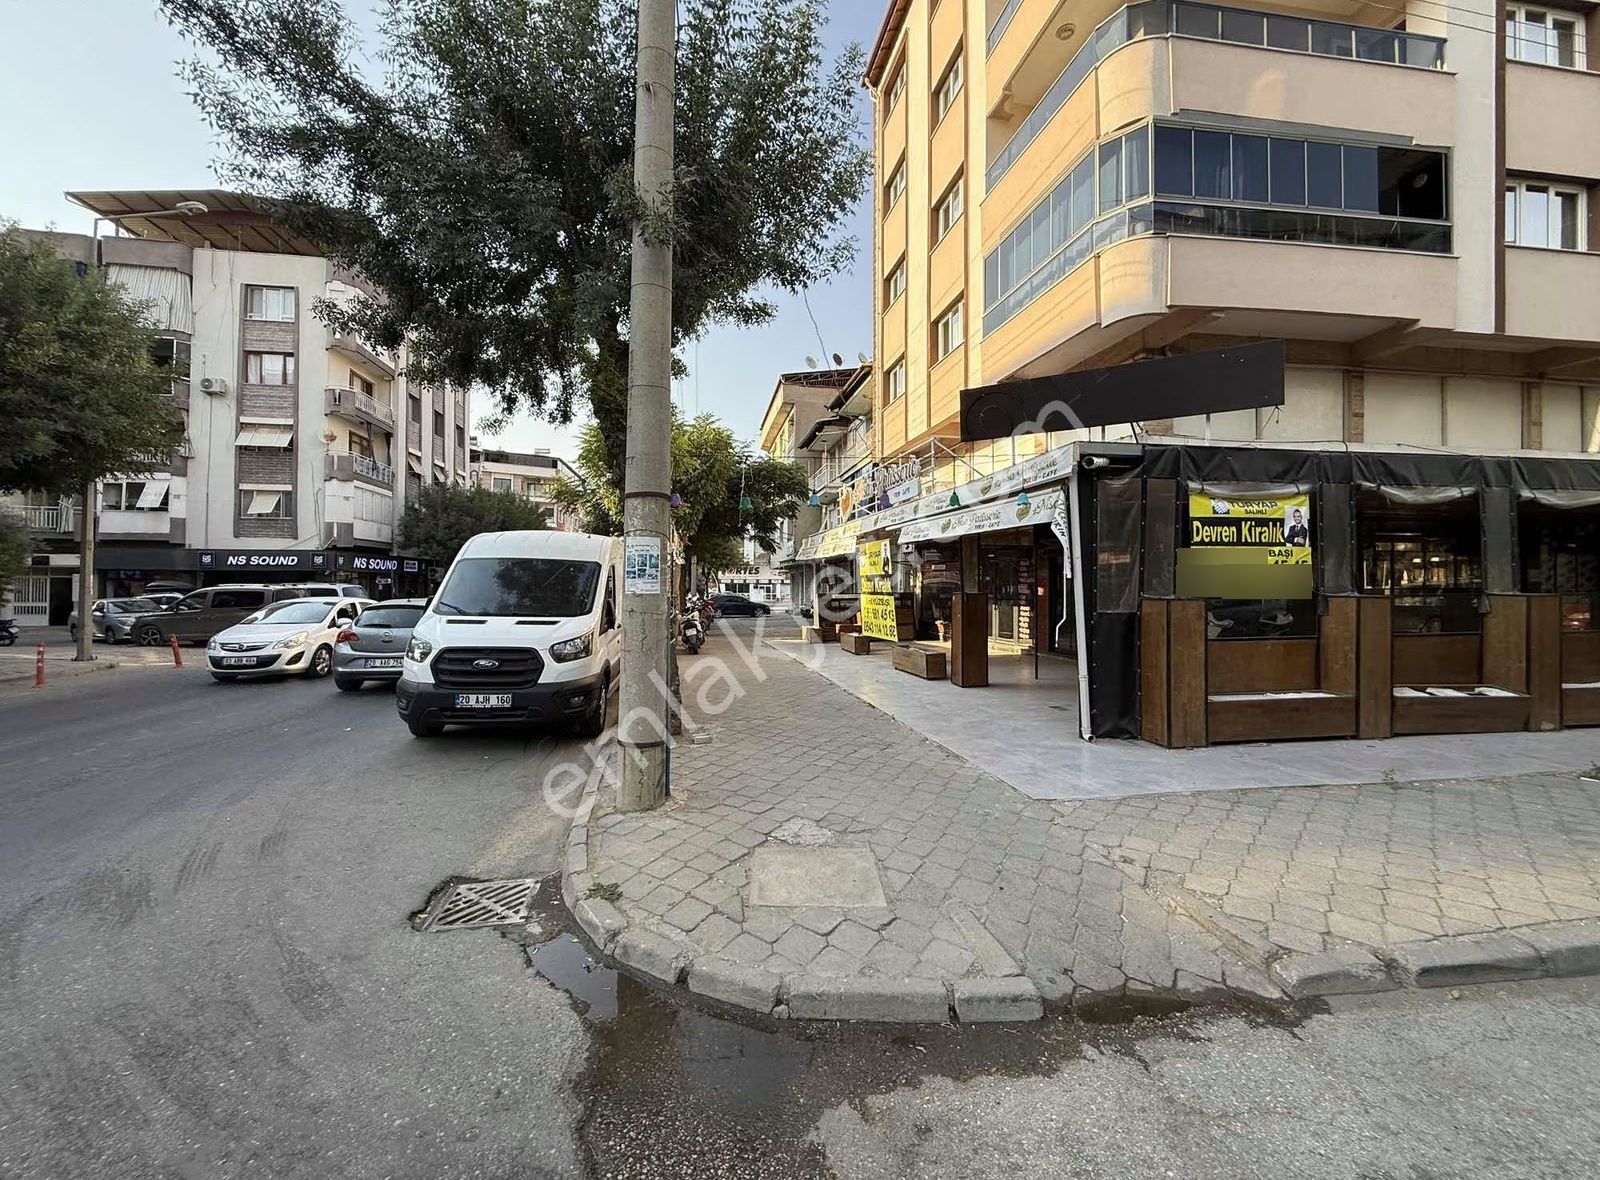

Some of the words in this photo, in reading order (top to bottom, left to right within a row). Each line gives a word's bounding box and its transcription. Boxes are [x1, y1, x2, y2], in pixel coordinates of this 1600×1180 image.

[1230, 500, 1278, 509] TURYAP
[1192, 520, 1237, 543] Devren
[1241, 520, 1285, 543] Kiralık
[1268, 549, 1293, 559] BAŞI
[227, 556, 247, 565] NS
[249, 556, 298, 566] SOUND
[353, 556, 367, 569] NS
[368, 558, 398, 570] SOUND
[460, 695, 470, 704] 20
[475, 695, 490, 704] AJH
[496, 695, 511, 704] 160
